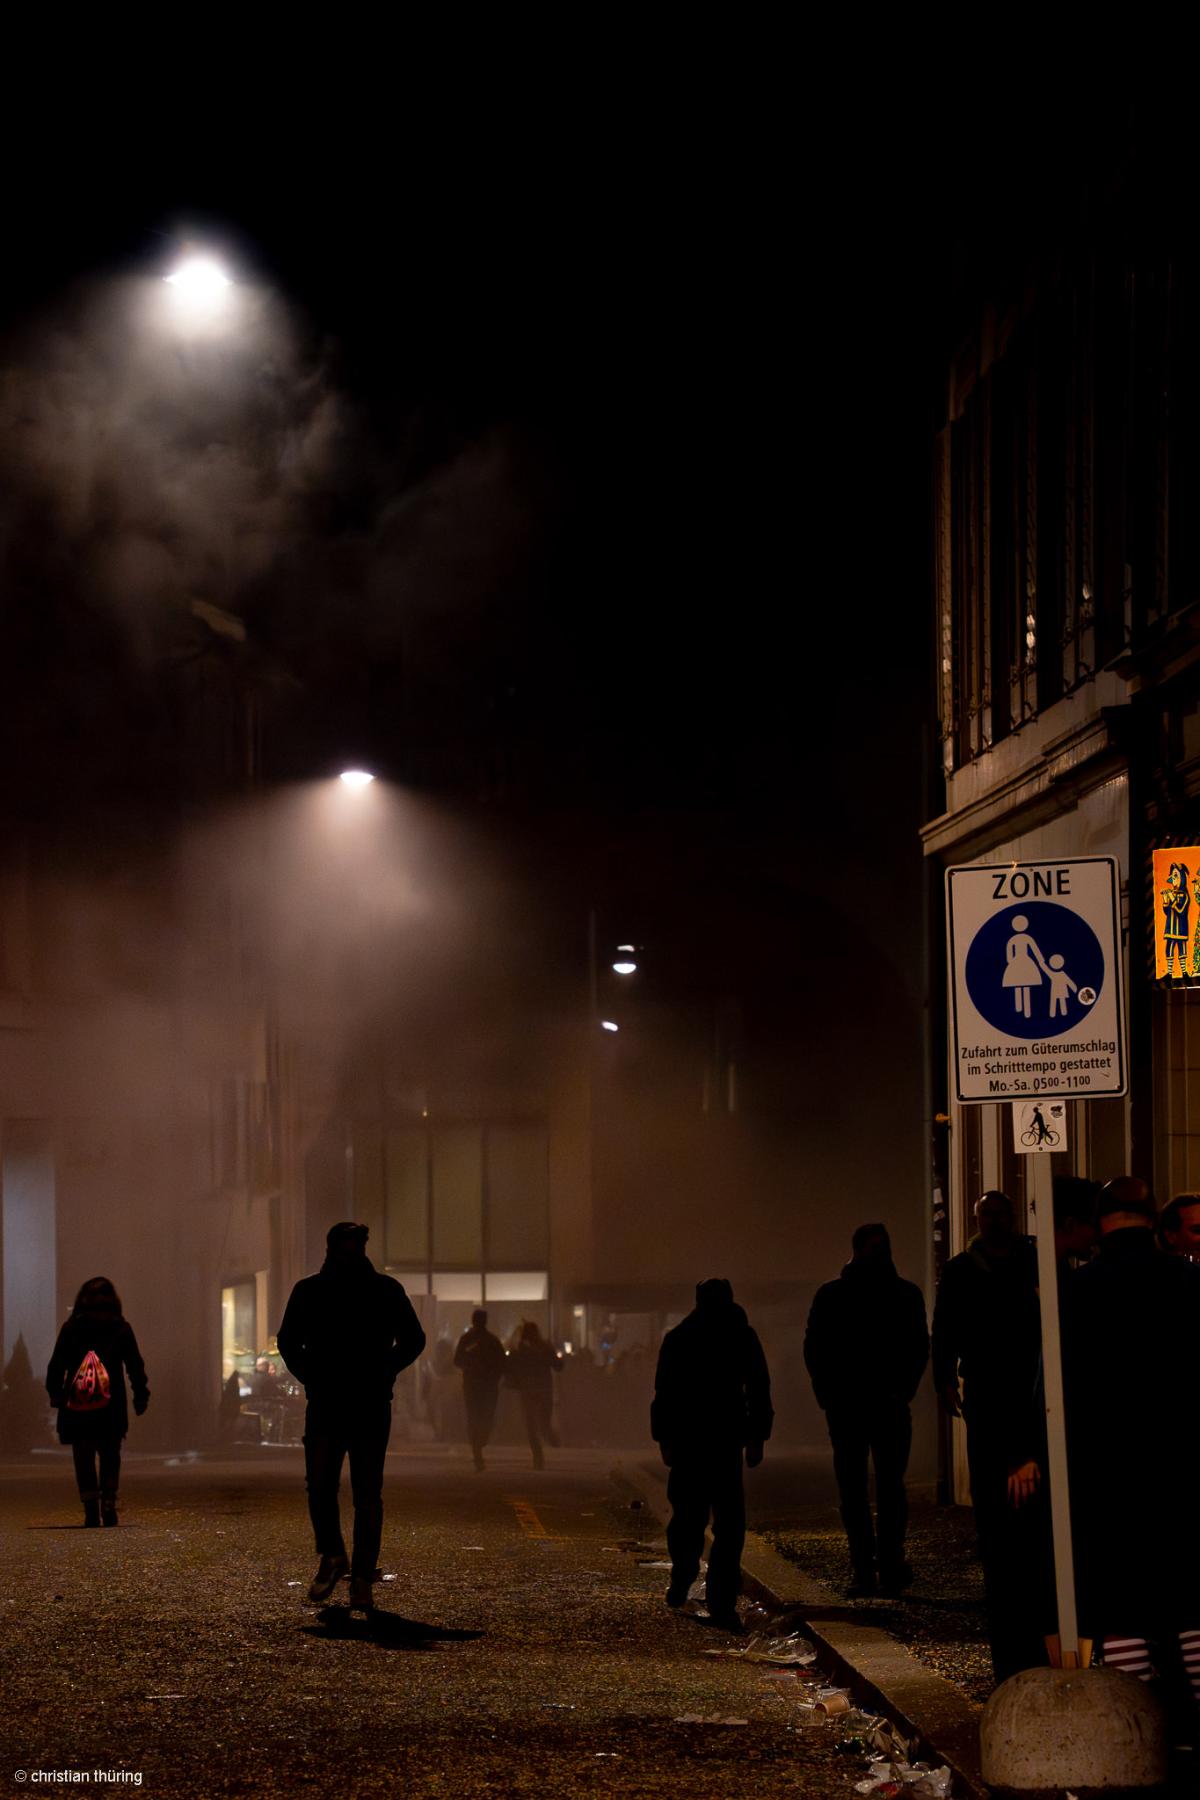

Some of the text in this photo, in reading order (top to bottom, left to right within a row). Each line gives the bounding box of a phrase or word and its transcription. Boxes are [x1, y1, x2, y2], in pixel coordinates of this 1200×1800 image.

[992, 870, 1071, 899] ZONE
[962, 1040, 1116, 1059] Zufahrt zum Güterumschlag
[968, 1057, 1111, 1075] im Schritttempo gestattet
[989, 1079, 1031, 1092] Mo.-Sa.
